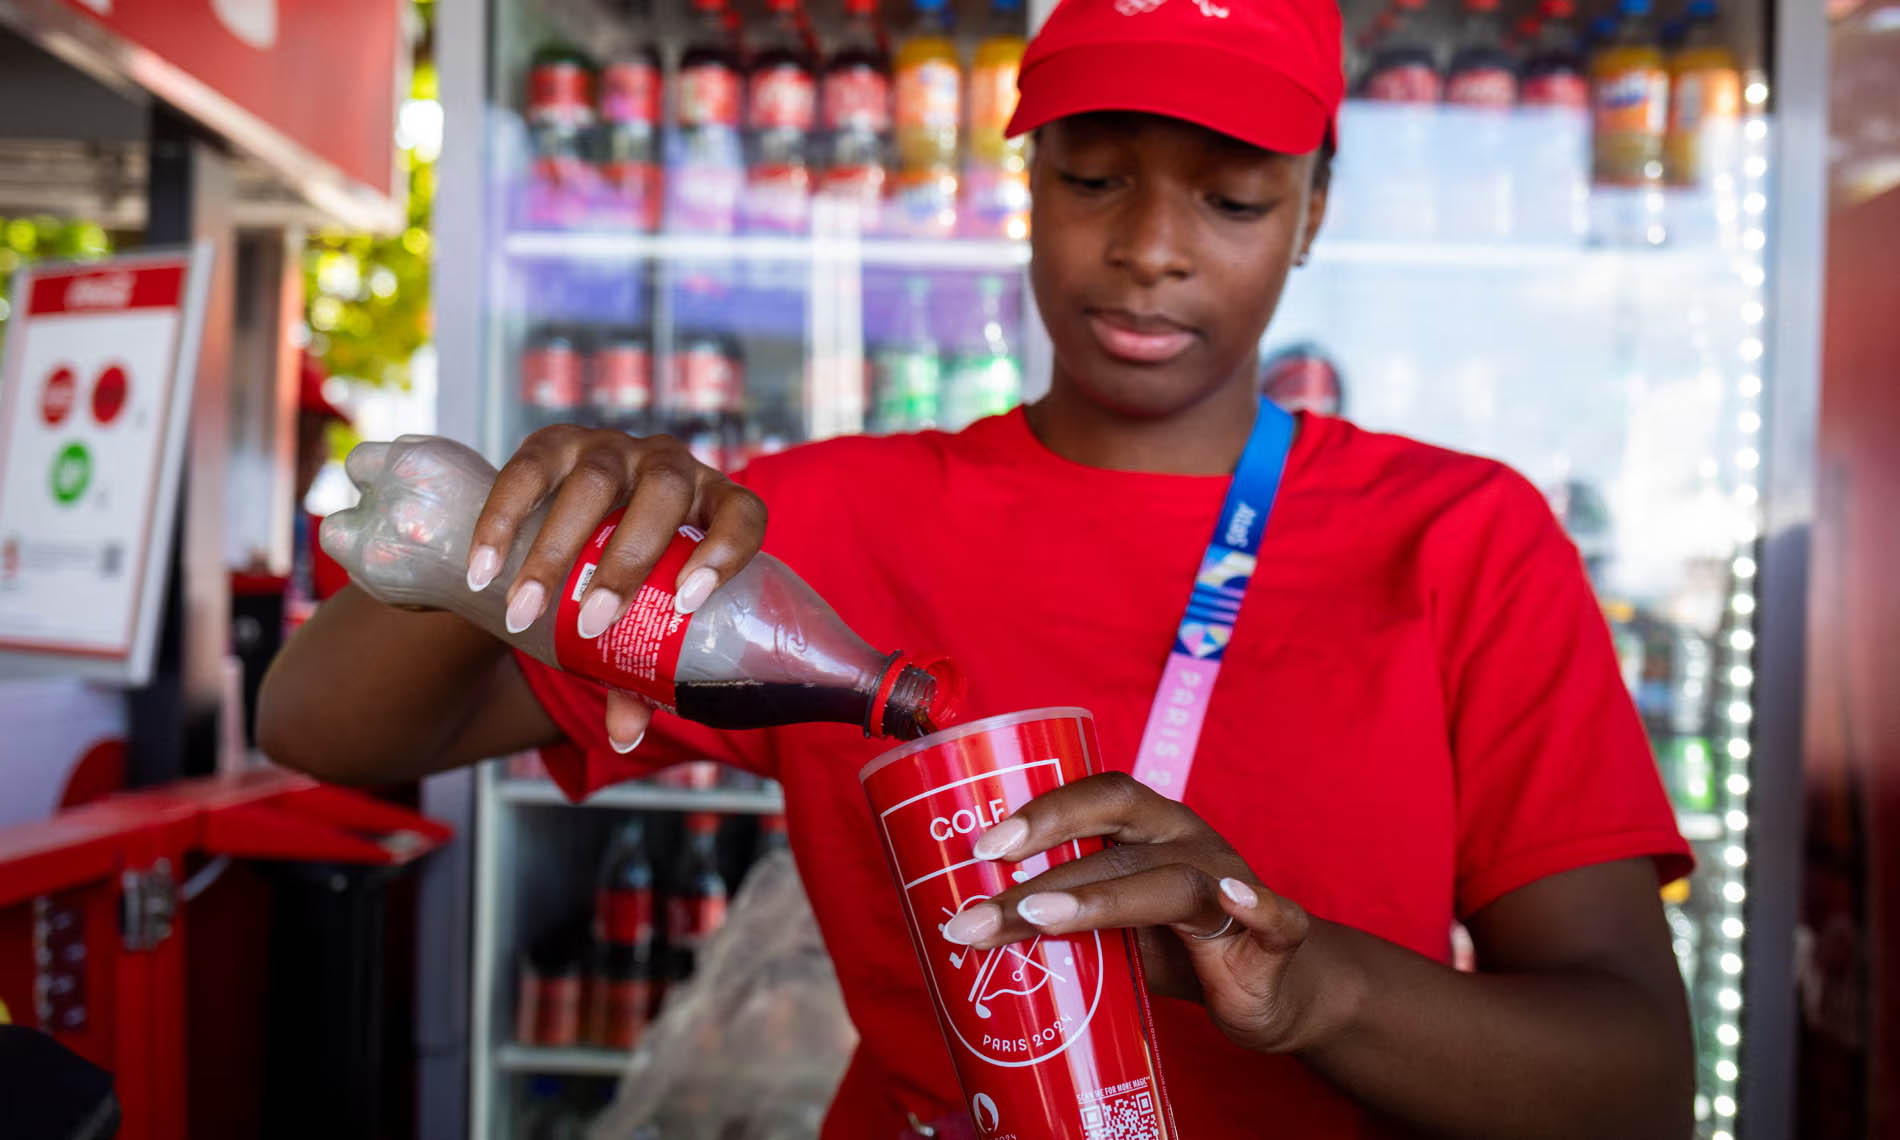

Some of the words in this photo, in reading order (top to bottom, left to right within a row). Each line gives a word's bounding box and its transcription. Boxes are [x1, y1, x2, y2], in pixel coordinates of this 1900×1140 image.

[1155, 669, 1202, 758] PARIS
[929, 798, 1006, 842] GOLF
[983, 1034, 1028, 1053] PARIS
[1032, 1013, 1073, 1048] 2024
[1105, 1085, 1117, 1096] FOR
[1116, 1081, 1132, 1093] MORE
